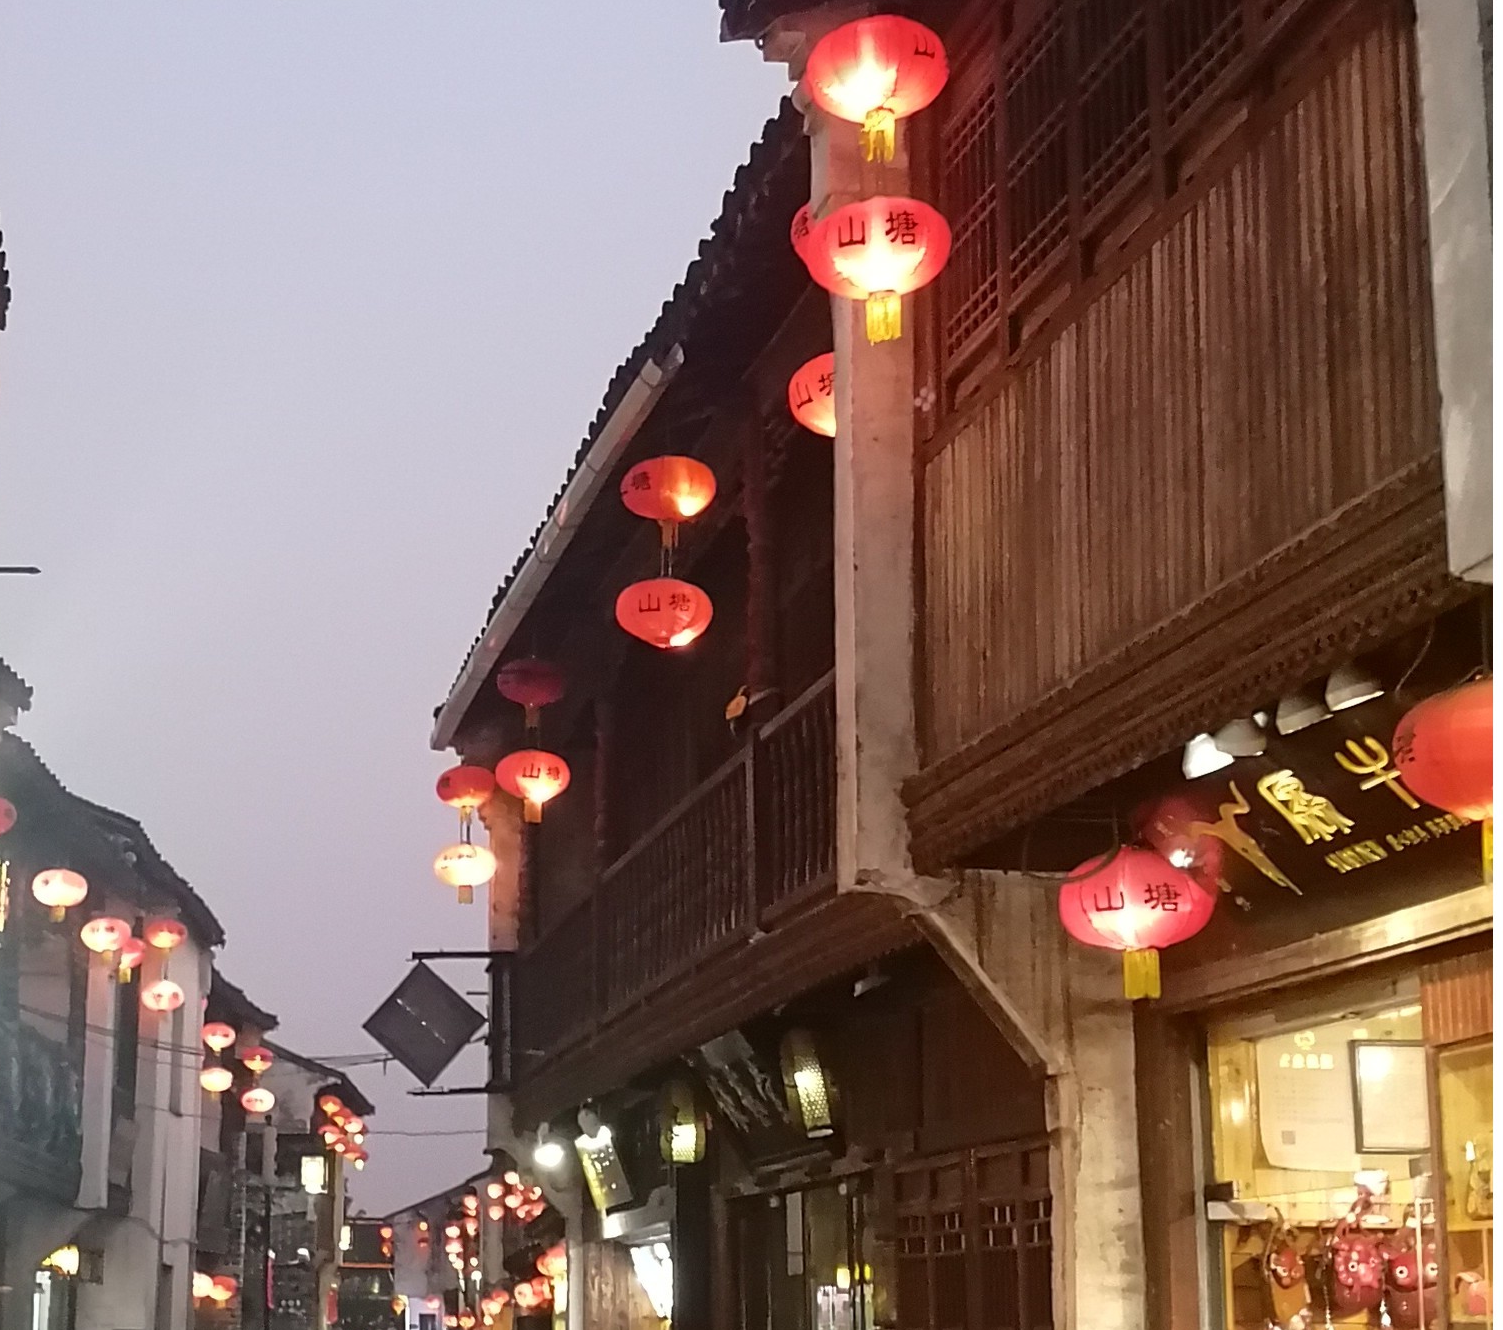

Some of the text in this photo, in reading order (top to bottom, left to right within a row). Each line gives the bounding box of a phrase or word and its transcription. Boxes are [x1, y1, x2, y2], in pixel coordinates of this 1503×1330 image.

[838, 210, 919, 248] 山塘
[638, 592, 691, 613] 山塘
[522, 763, 561, 780] 山塘
[1094, 883, 1182, 913] 山塘
